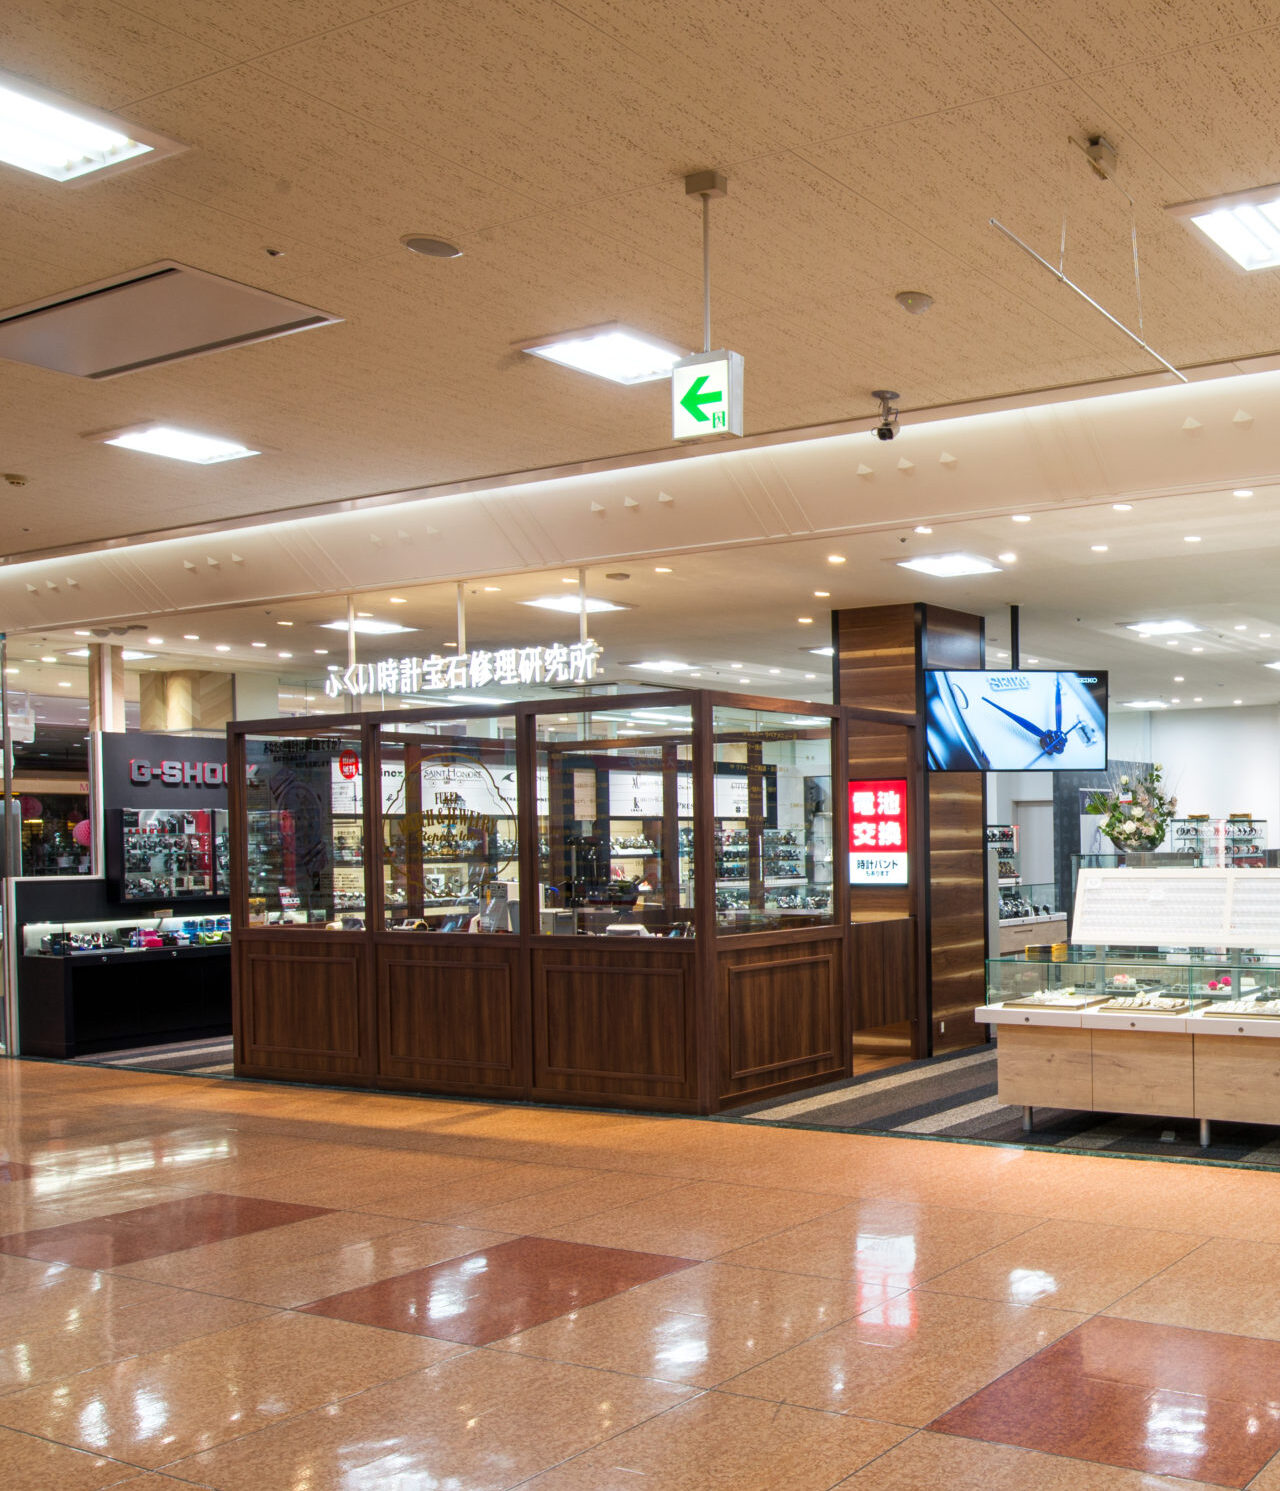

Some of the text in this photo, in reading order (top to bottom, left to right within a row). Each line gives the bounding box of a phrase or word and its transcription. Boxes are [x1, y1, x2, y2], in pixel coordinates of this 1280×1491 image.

[325, 643, 600, 697] ふくい時計宝石修理研究所
[129, 759, 259, 788] G-SHOK
[852, 790, 902, 816] 電池
[853, 821, 902, 846] 交換
[856, 859, 899, 870] 時計バンド
